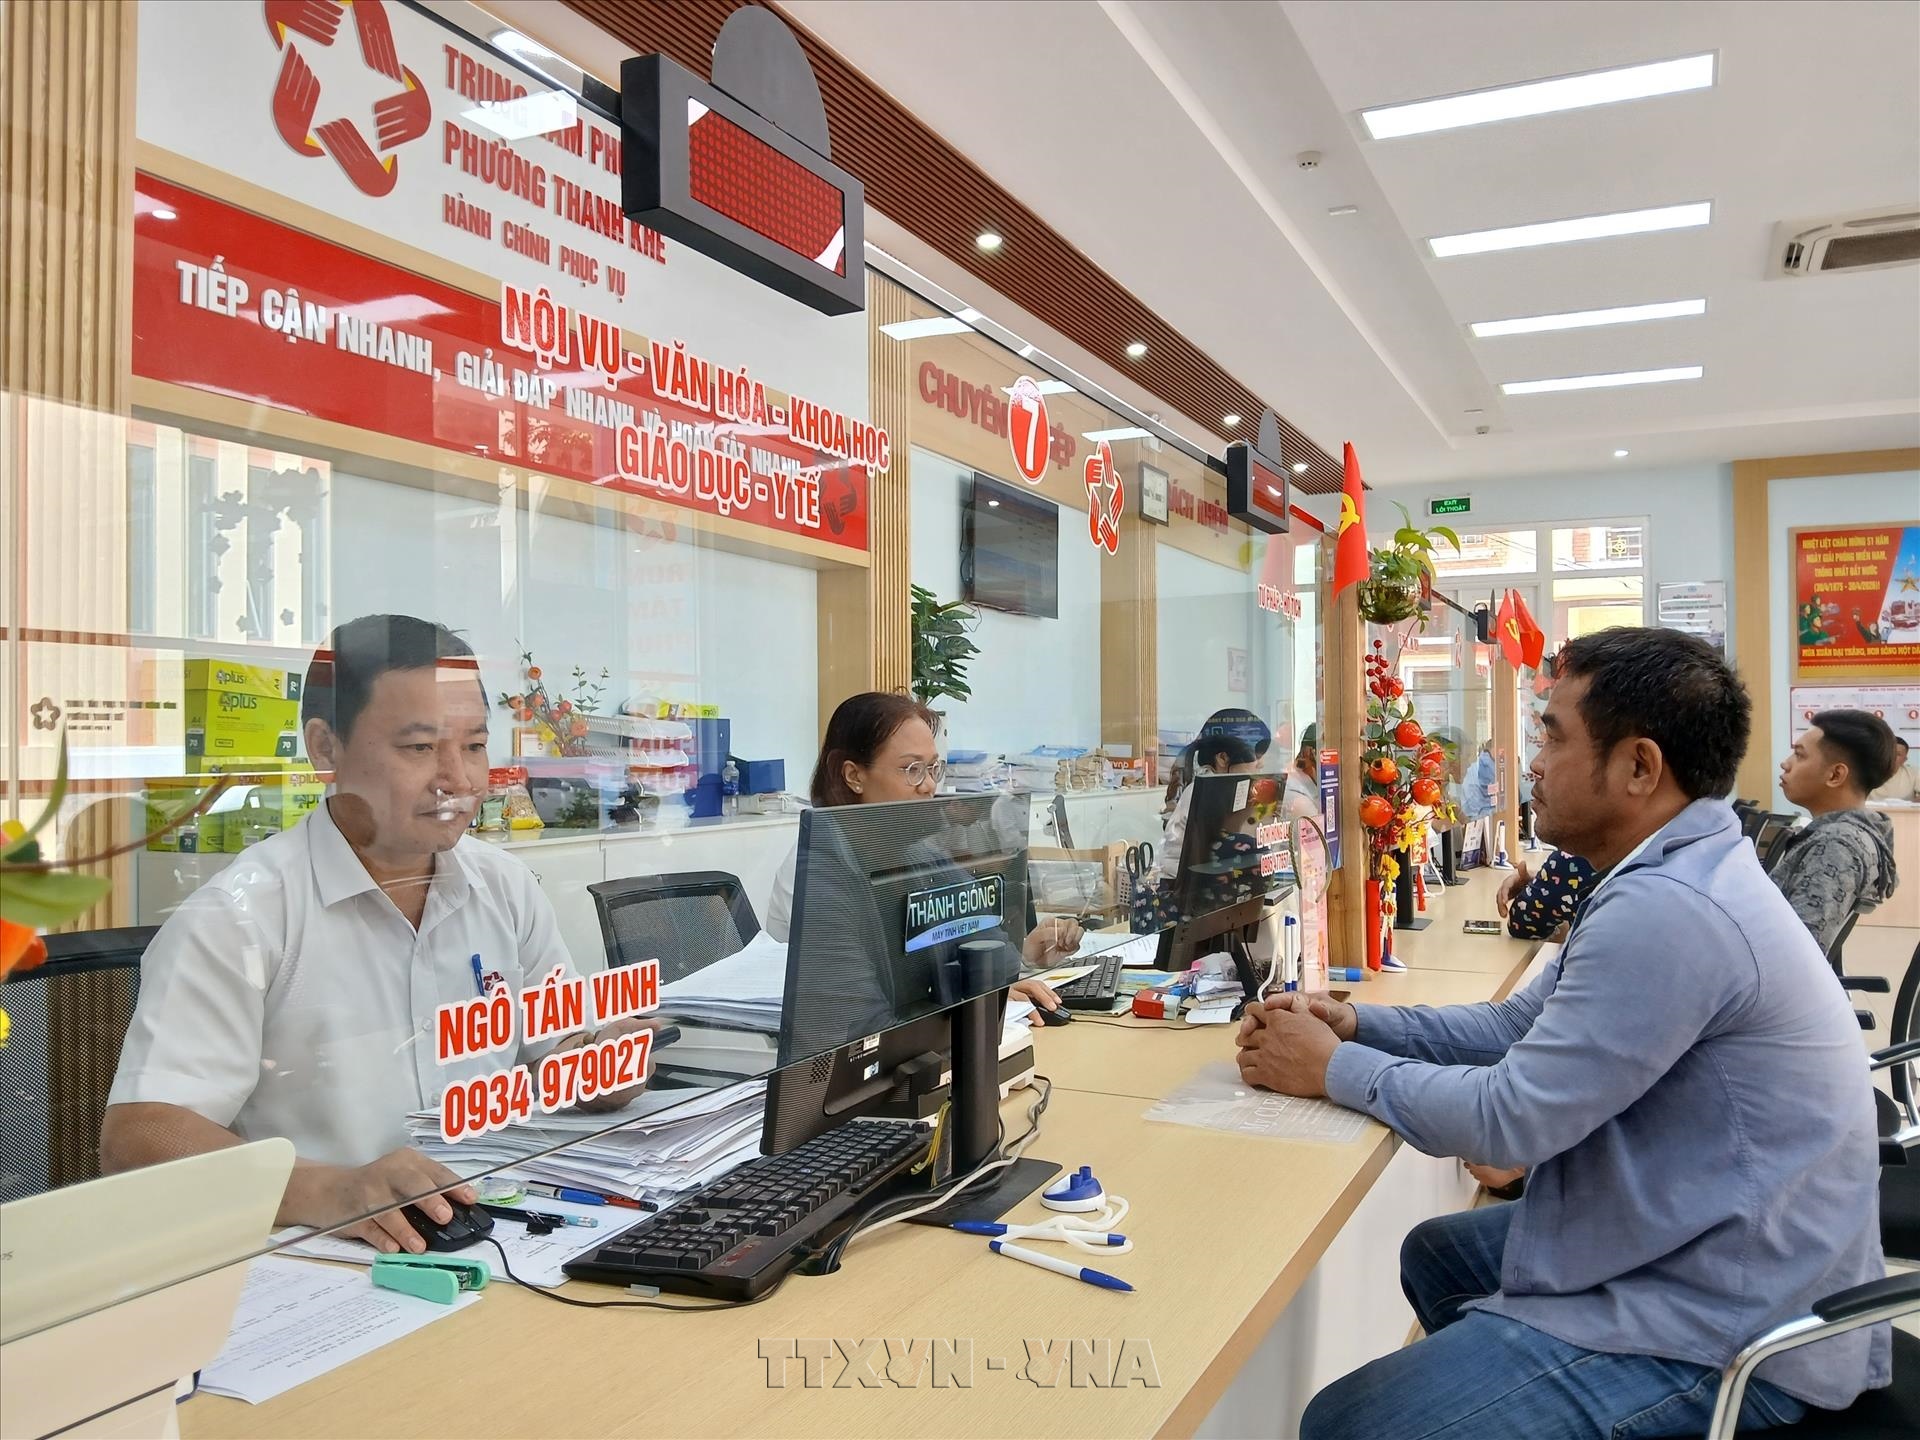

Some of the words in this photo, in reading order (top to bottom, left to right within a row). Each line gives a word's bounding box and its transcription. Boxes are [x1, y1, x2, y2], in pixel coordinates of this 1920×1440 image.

[443, 120, 546, 209] PHƯỜNG
[551, 174, 625, 244] THANH
[443, 193, 492, 240] HÀNH
[502, 219, 550, 265] CHÍNH
[559, 245, 598, 287] PHỤC
[607, 265, 626, 303] VỤ
[177, 255, 249, 317] TIẾP
[260, 288, 326, 343] CẬN
[335, 312, 441, 382] NHANH,
[455, 348, 504, 396] GIẢI
[513, 366, 557, 410] ĐÁP
[566, 386, 634, 430] NHANH
[503, 285, 568, 366] NỘI
[579, 313, 621, 386] VỤ
[651, 340, 709, 409] VĂN
[717, 368, 767, 426] HÓA
[790, 395, 847, 456] KHOA
[852, 422, 890, 474] HỌC
[919, 361, 1008, 438] CHUYÊN
[1021, 397, 1040, 471] 7
[619, 425, 689, 489] GIÁO
[698, 450, 749, 512] DỤC
[772, 472, 788, 516] Y
[795, 470, 821, 524] TẾ
[282, 741, 291, 749] 70
[910, 893, 955, 928] THÁNH
[958, 884, 996, 914] GIÓNG
[439, 986, 512, 1060] NGÔ
[522, 967, 583, 1039] TẤN
[593, 963, 657, 1021] VINH
[444, 1070, 531, 1138] 0934
[542, 1033, 650, 1108] 979027
